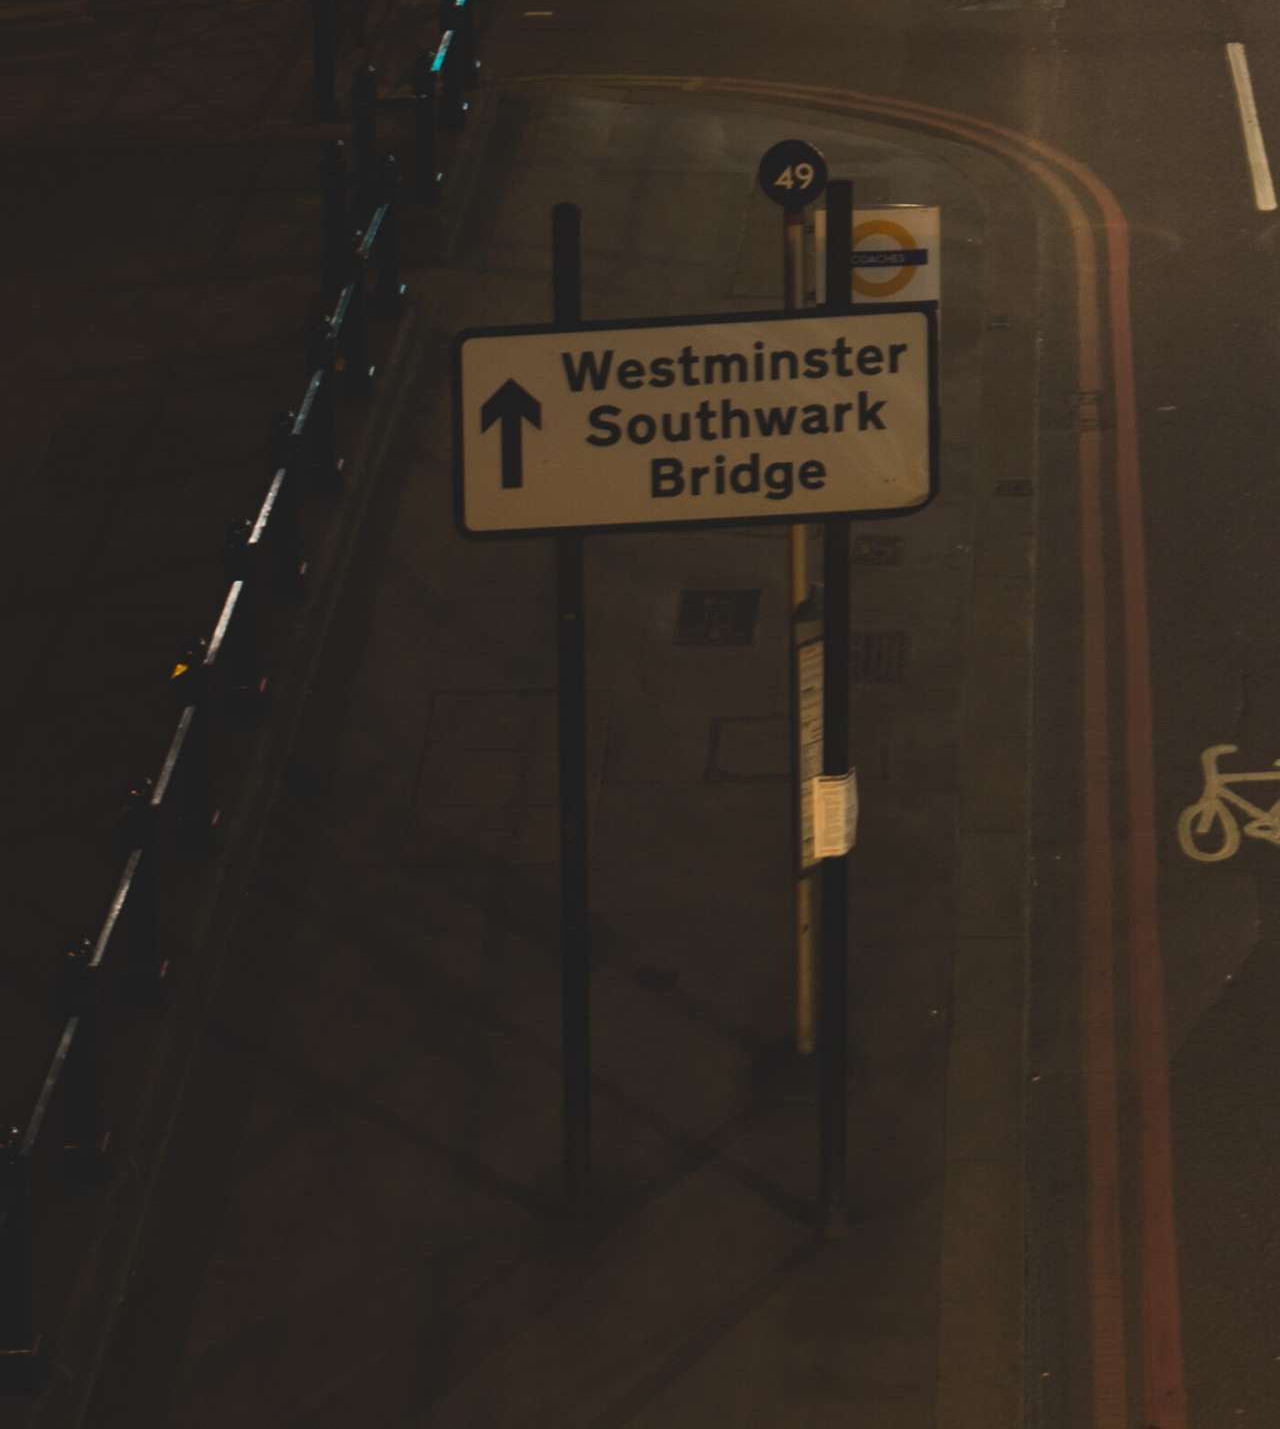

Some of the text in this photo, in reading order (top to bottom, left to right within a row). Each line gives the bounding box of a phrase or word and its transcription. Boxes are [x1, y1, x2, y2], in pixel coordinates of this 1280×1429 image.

[775, 163, 814, 189] 49
[562, 340, 908, 392] Westminster
[585, 391, 886, 447] Southwark
[651, 452, 827, 501] Bridge
